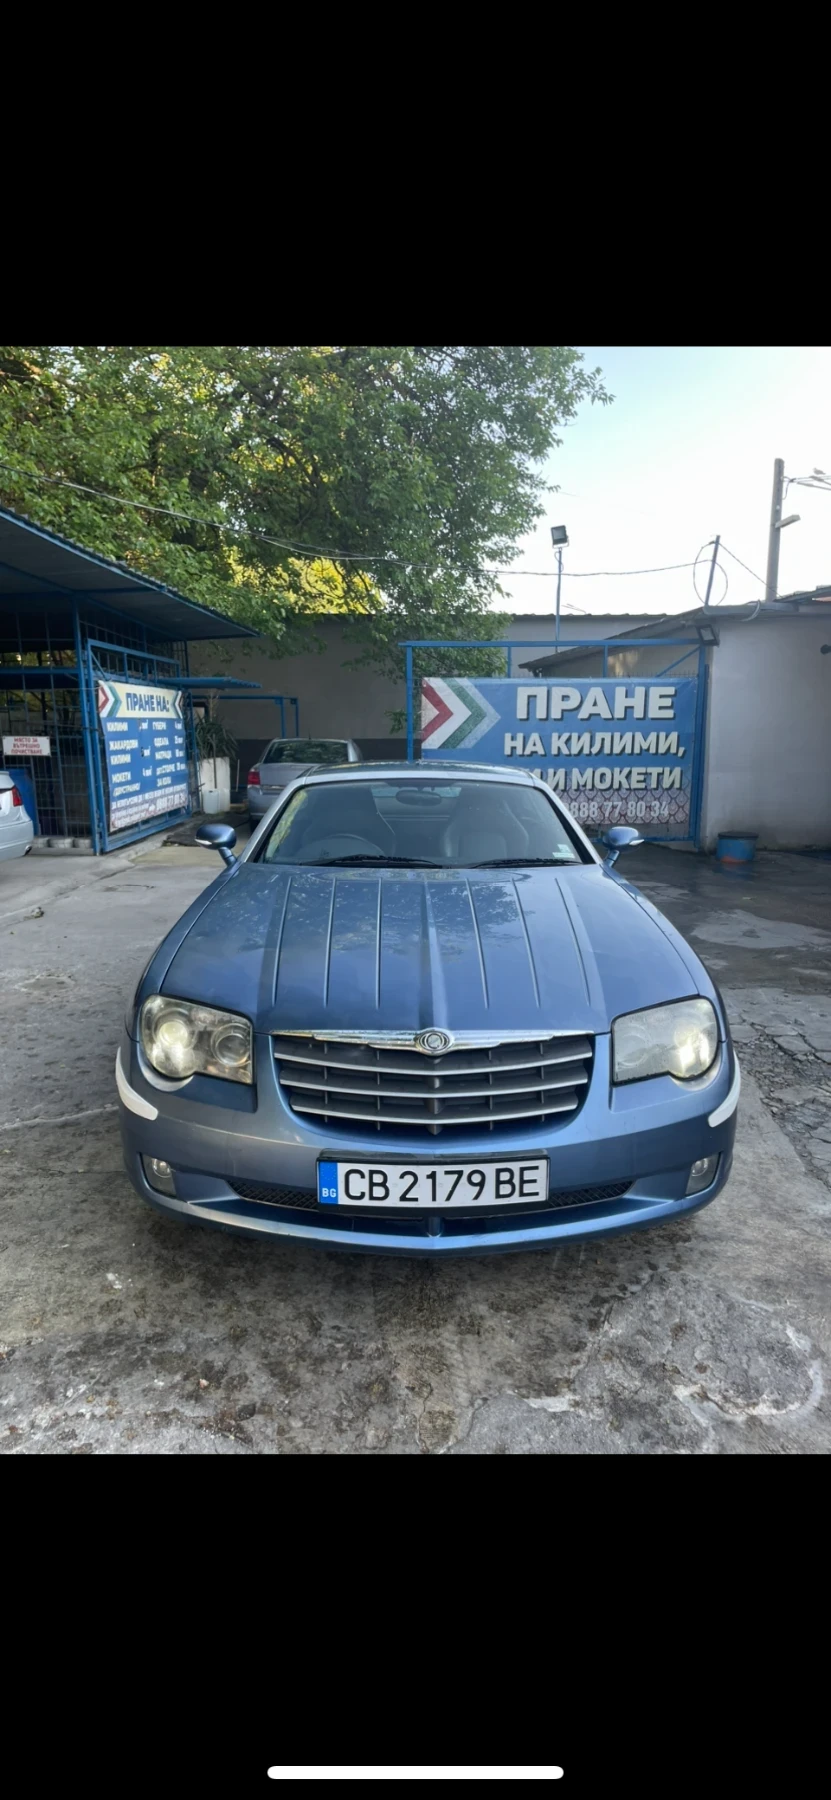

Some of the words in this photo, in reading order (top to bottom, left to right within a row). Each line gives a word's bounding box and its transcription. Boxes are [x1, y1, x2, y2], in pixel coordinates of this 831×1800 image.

[125, 692, 155, 712] ПРАНЕ
[156, 694, 170, 712] НА:
[516, 686, 676, 721] ПРАНЕ
[504, 732, 546, 756] НА
[551, 731, 686, 758] КИЛИМИ,
[572, 767, 683, 791] МОКЕТИ
[603, 801, 622, 818] 77
[627, 801, 646, 818] 80
[650, 801, 669, 818] 34
[322, 1187, 337, 1198] BG
[344, 1168, 391, 1201] CB
[399, 1169, 487, 1202] 2179
[495, 1165, 540, 1200] BE
